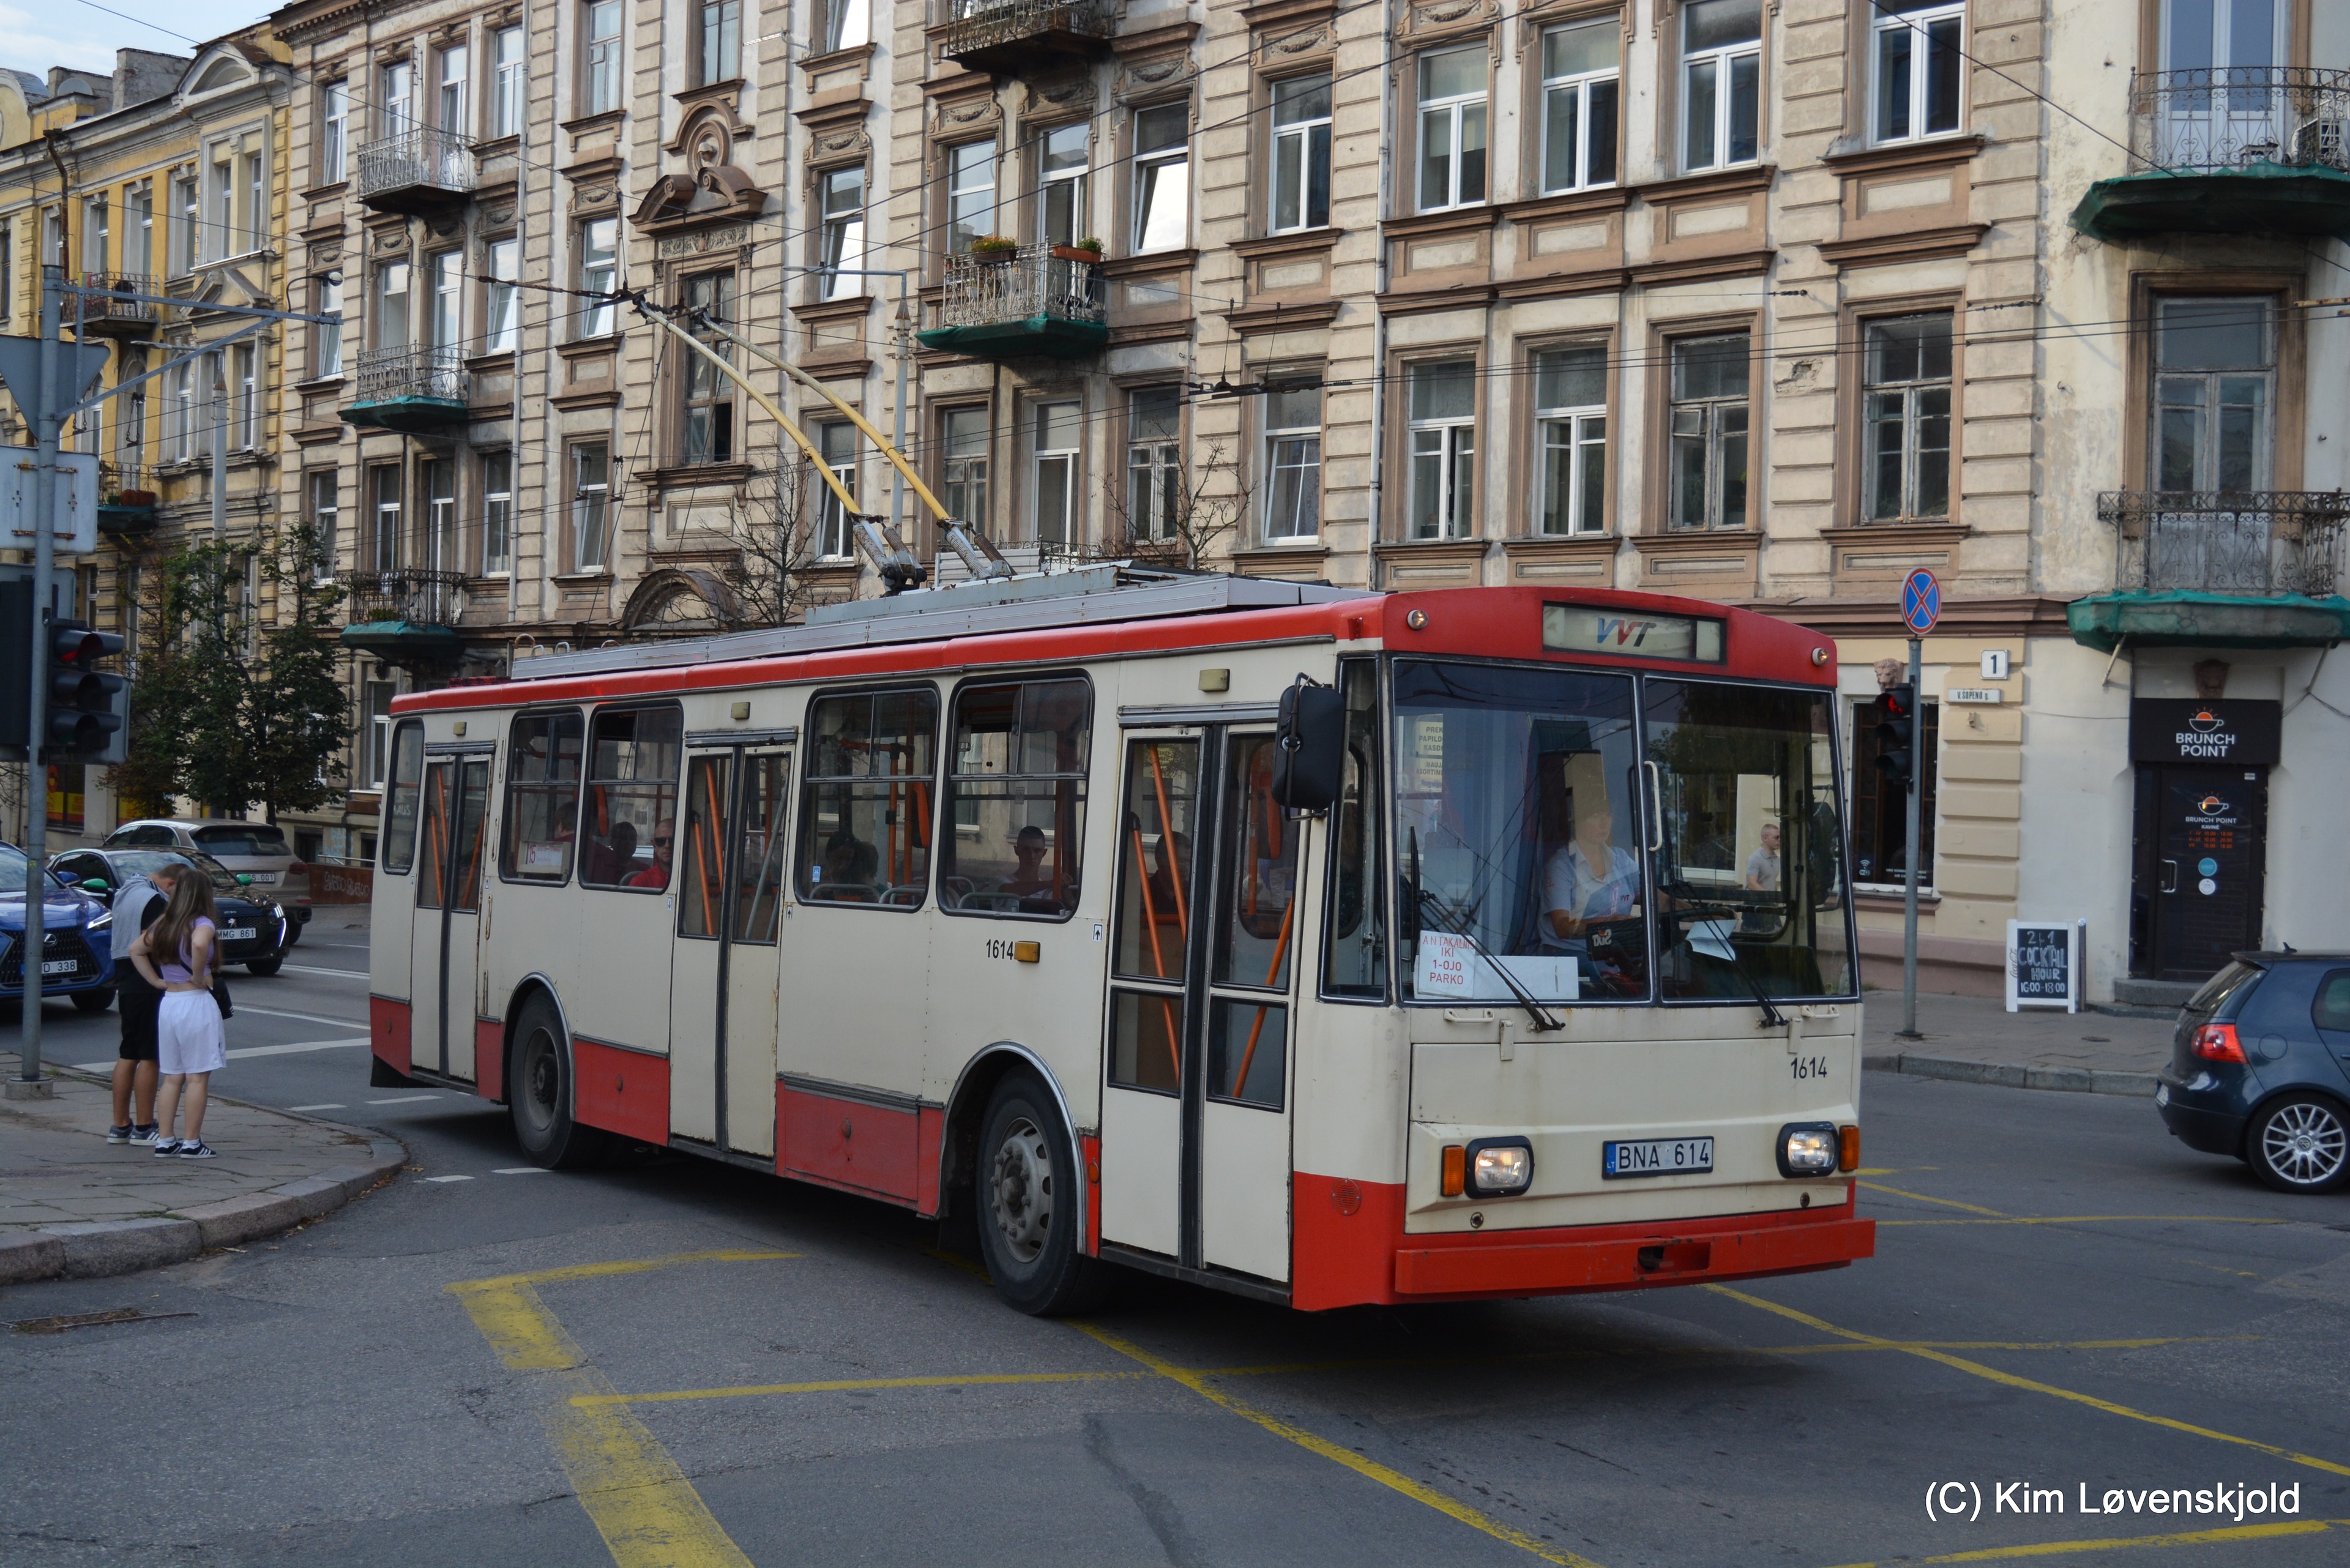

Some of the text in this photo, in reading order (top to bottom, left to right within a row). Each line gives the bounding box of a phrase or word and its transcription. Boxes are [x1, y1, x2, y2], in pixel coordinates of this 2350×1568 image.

[1597, 617, 1657, 648] VVT
[1990, 654, 1997, 674] 1
[2176, 733, 2235, 745] BRUNCH
[2180, 745, 2228, 757] POINT
[529, 844, 537, 864] 15
[240, 929, 254, 938] 861
[986, 938, 1013, 960] 1614
[1441, 947, 1454, 958] IKI
[2018, 945, 2067, 968] COCKTAIL
[58, 961, 75, 972] 338
[2031, 968, 2061, 981] HOUR
[1430, 972, 1464, 985] PARKO
[1790, 1056, 1827, 1079] 1614
[1619, 1144, 1660, 1170] BNA
[1674, 1141, 1709, 1166] 614
